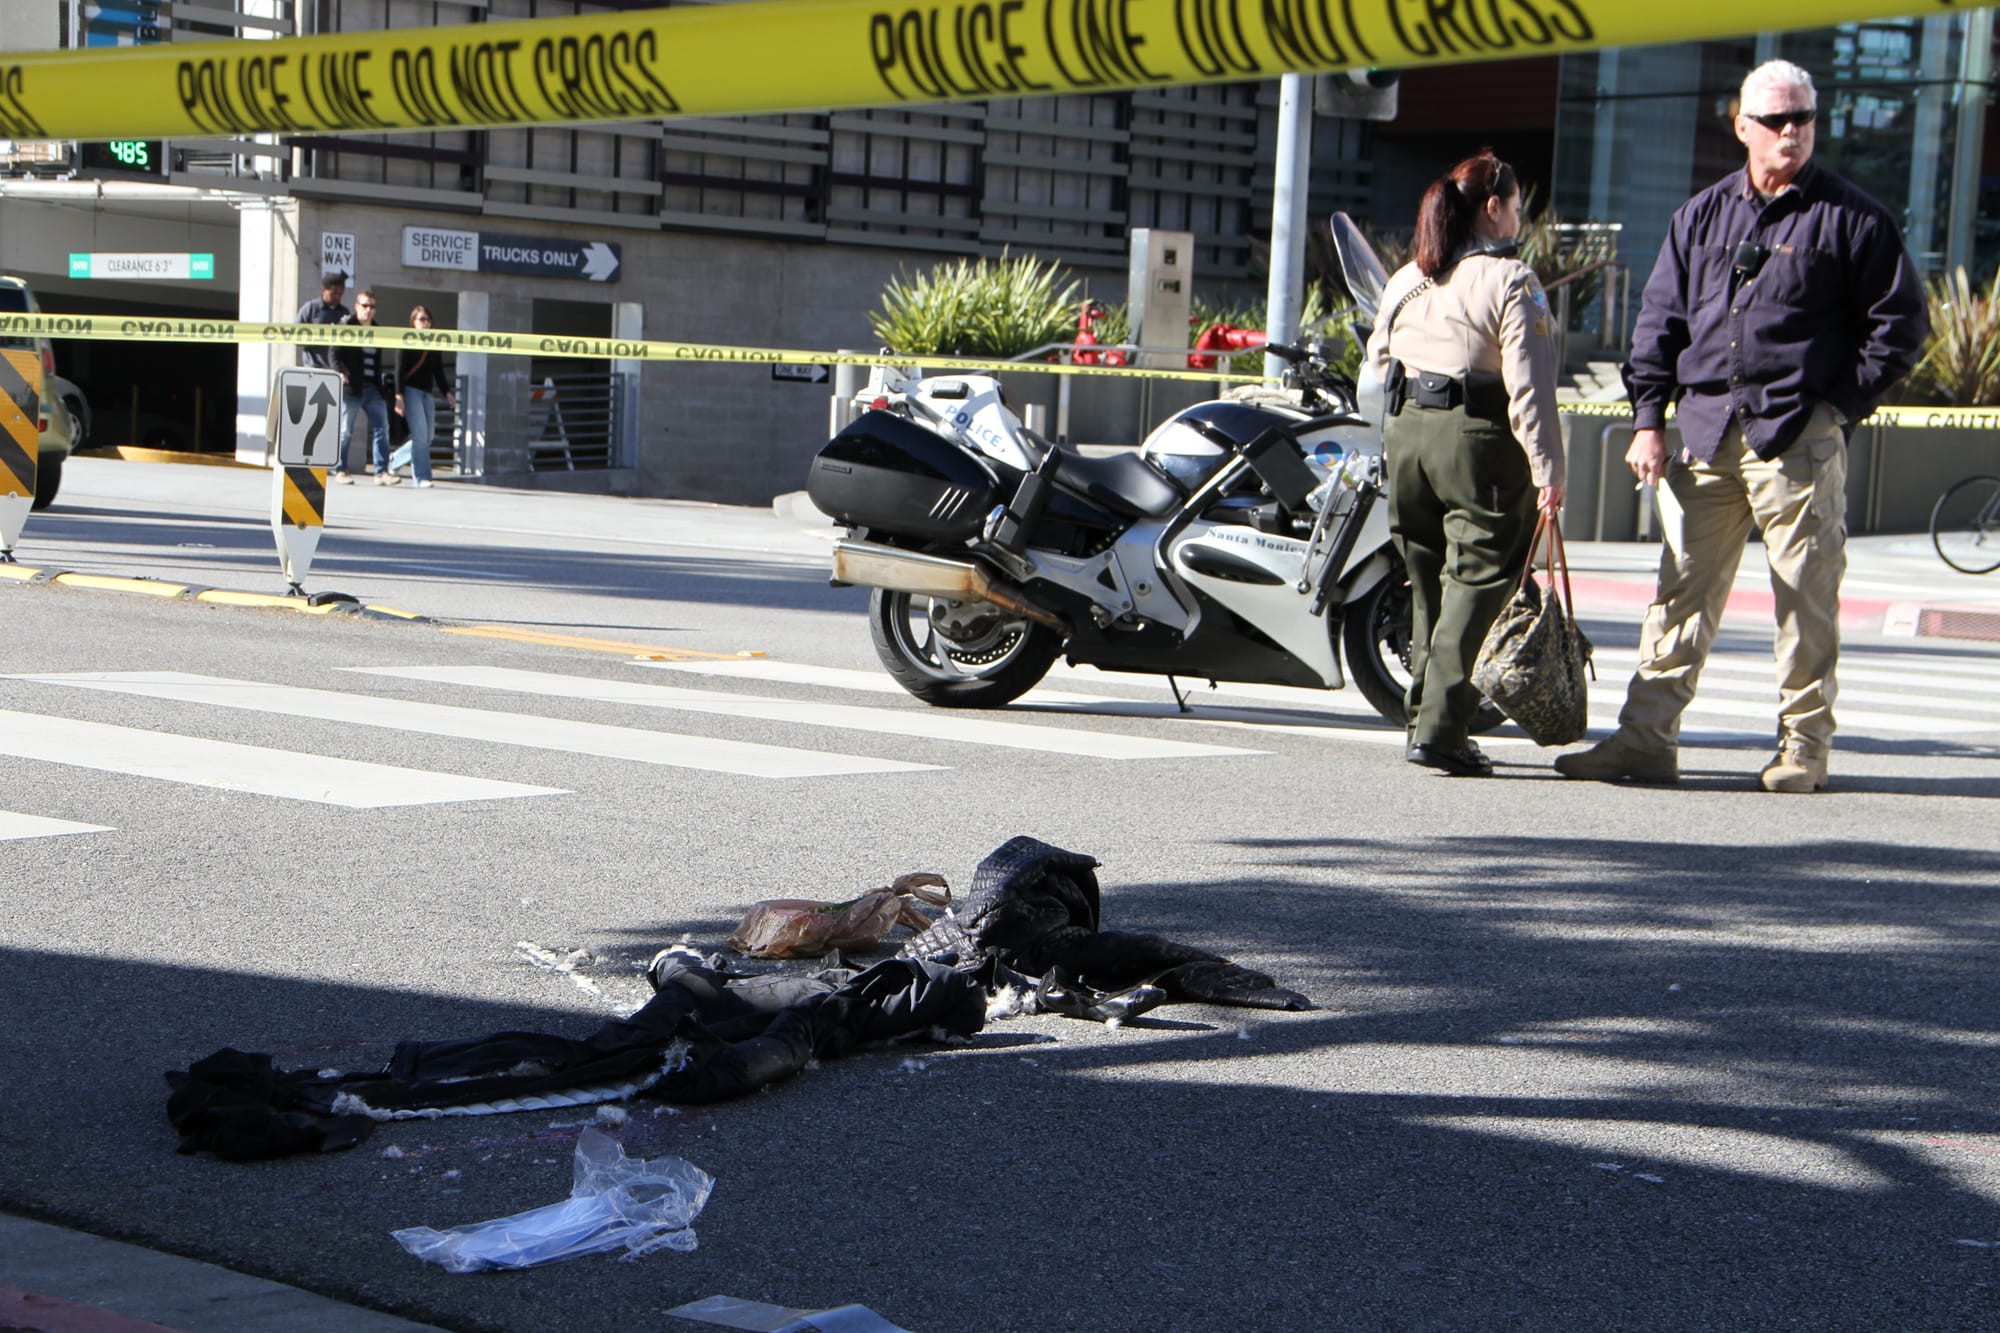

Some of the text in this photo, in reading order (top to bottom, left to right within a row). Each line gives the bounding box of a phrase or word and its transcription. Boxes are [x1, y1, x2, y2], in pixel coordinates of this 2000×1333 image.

[870, 1, 1053, 100] POLICE
[1044, 0, 1174, 85] LINE
[1173, 0, 1261, 75] DO
[1262, 0, 1377, 69] NOT
[178, 29, 681, 134] POLICE LINE DO NOT CROSS
[110, 140, 148, 165] 485
[324, 236, 351, 250] ONE
[411, 232, 473, 250] SERVICE
[324, 252, 353, 266] WAY
[421, 248, 463, 265] DRIVE
[483, 245, 579, 267] TRUCKS ONLY
[107, 260, 153, 272] CLEARANCE
[945, 404, 1003, 448] POLICE
[1927, 412, 2000, 428] CAUTI
[1208, 526, 1249, 545] Santa
